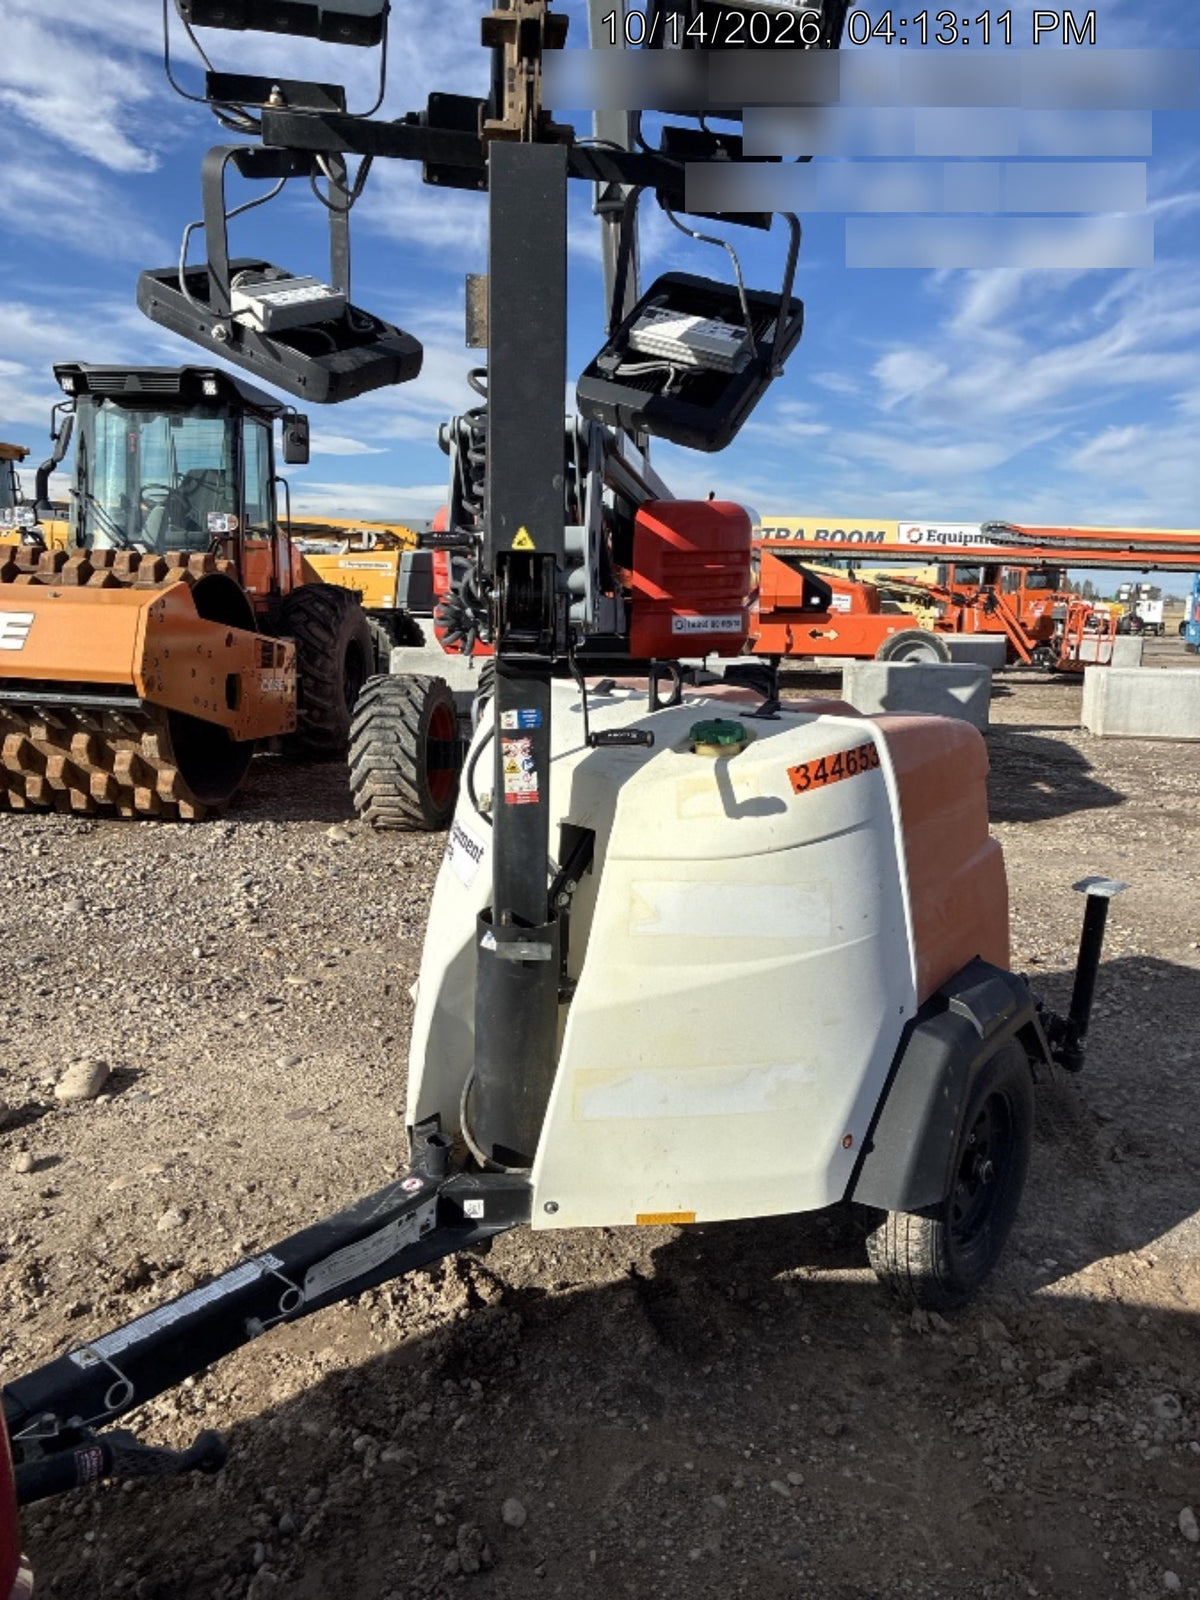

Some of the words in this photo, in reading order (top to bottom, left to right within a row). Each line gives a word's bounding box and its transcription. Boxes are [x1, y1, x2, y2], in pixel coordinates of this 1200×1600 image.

[814, 529, 887, 544] BOOM
[926, 529, 1000, 547] Equipm
[794, 741, 880, 792] 344653
